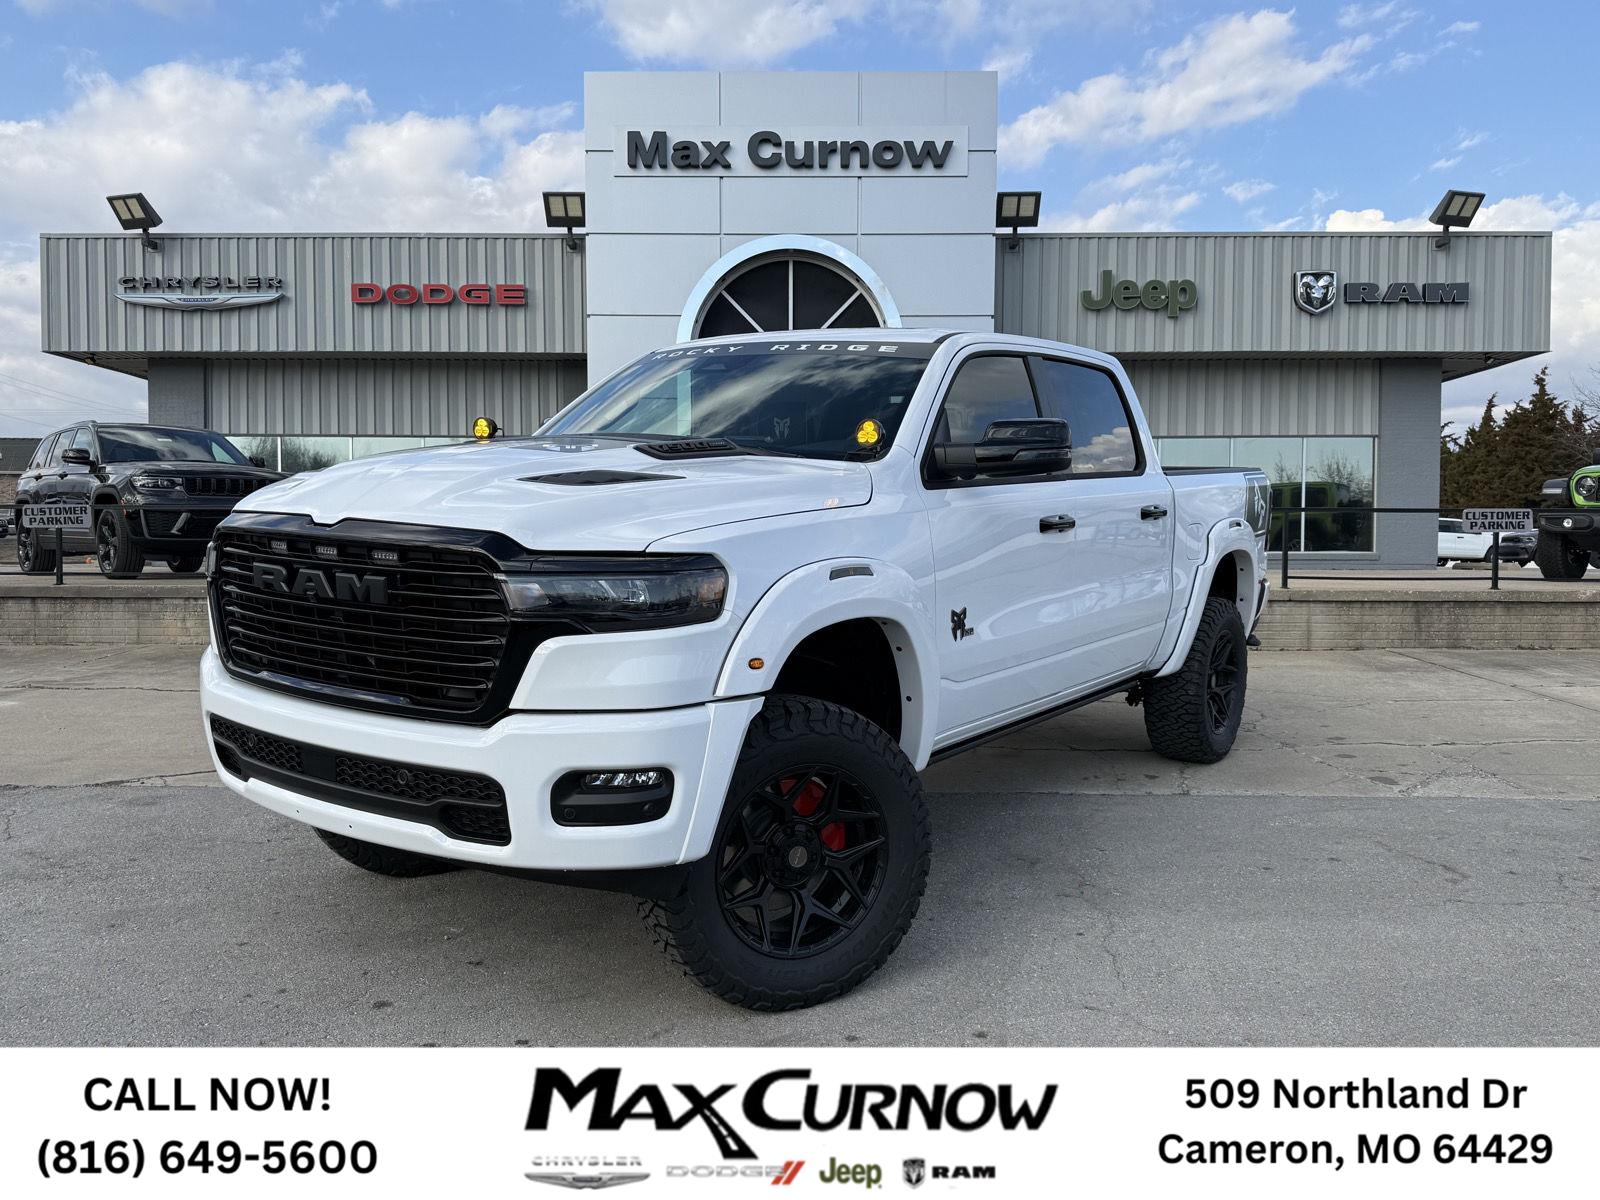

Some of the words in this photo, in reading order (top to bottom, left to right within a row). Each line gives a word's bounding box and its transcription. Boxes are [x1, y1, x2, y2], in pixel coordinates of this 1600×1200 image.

[627, 130, 732, 170] Max
[747, 130, 954, 170] Curnow
[118, 276, 284, 289] CHRYSLER
[351, 283, 527, 306] DODGE
[1080, 269, 1198, 319] Jeep
[1344, 282, 1470, 304] RAM
[651, 345, 744, 361] ROCKY
[770, 344, 899, 353] RIDGE
[24, 506, 88, 516] CUSTOMER
[1465, 511, 1530, 520] CUSTOMER
[29, 516, 84, 525] PARKING
[1470, 521, 1526, 530] PARKING
[253, 561, 389, 604] RAM
